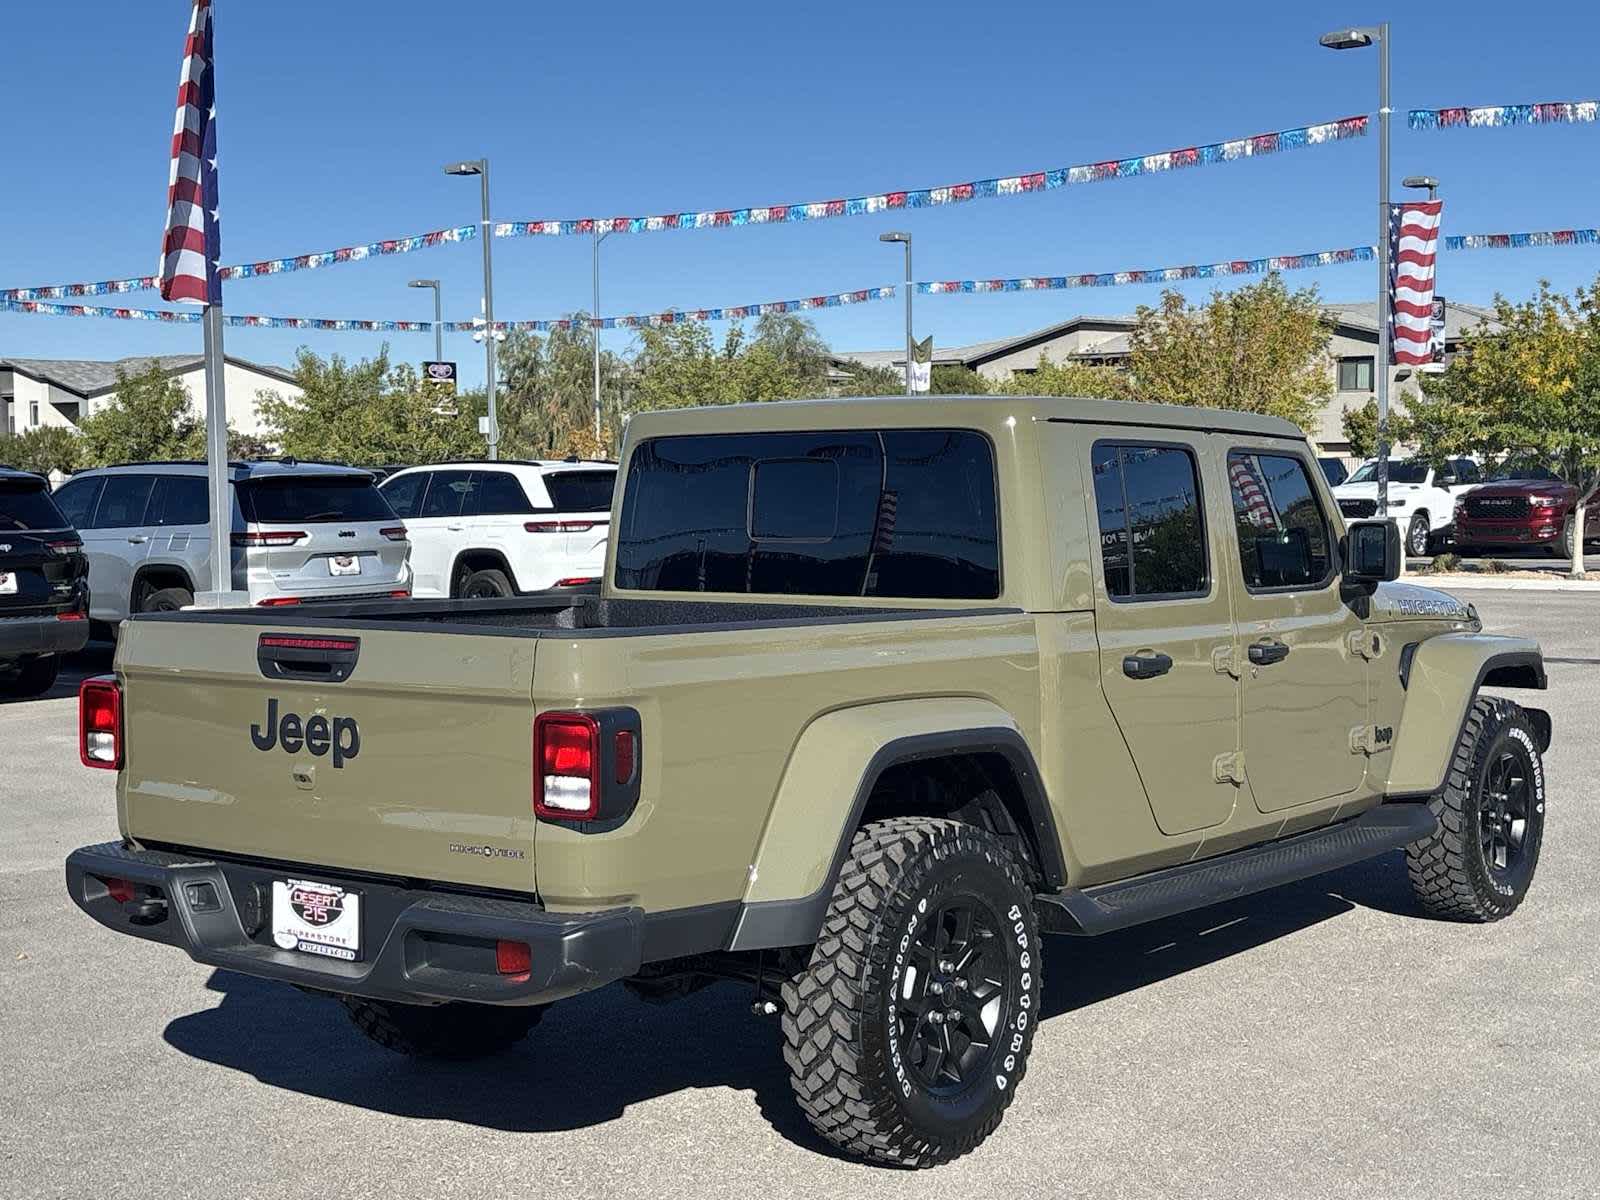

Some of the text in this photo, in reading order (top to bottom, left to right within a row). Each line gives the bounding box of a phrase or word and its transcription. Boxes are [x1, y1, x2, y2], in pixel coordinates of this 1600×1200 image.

[250, 698, 360, 768] Jeep
[293, 890, 338, 907] DESERT
[303, 905, 328, 922] 215
[288, 928, 347, 945] SUPERSTORE
[887, 914, 918, 1098] DESTINATION
